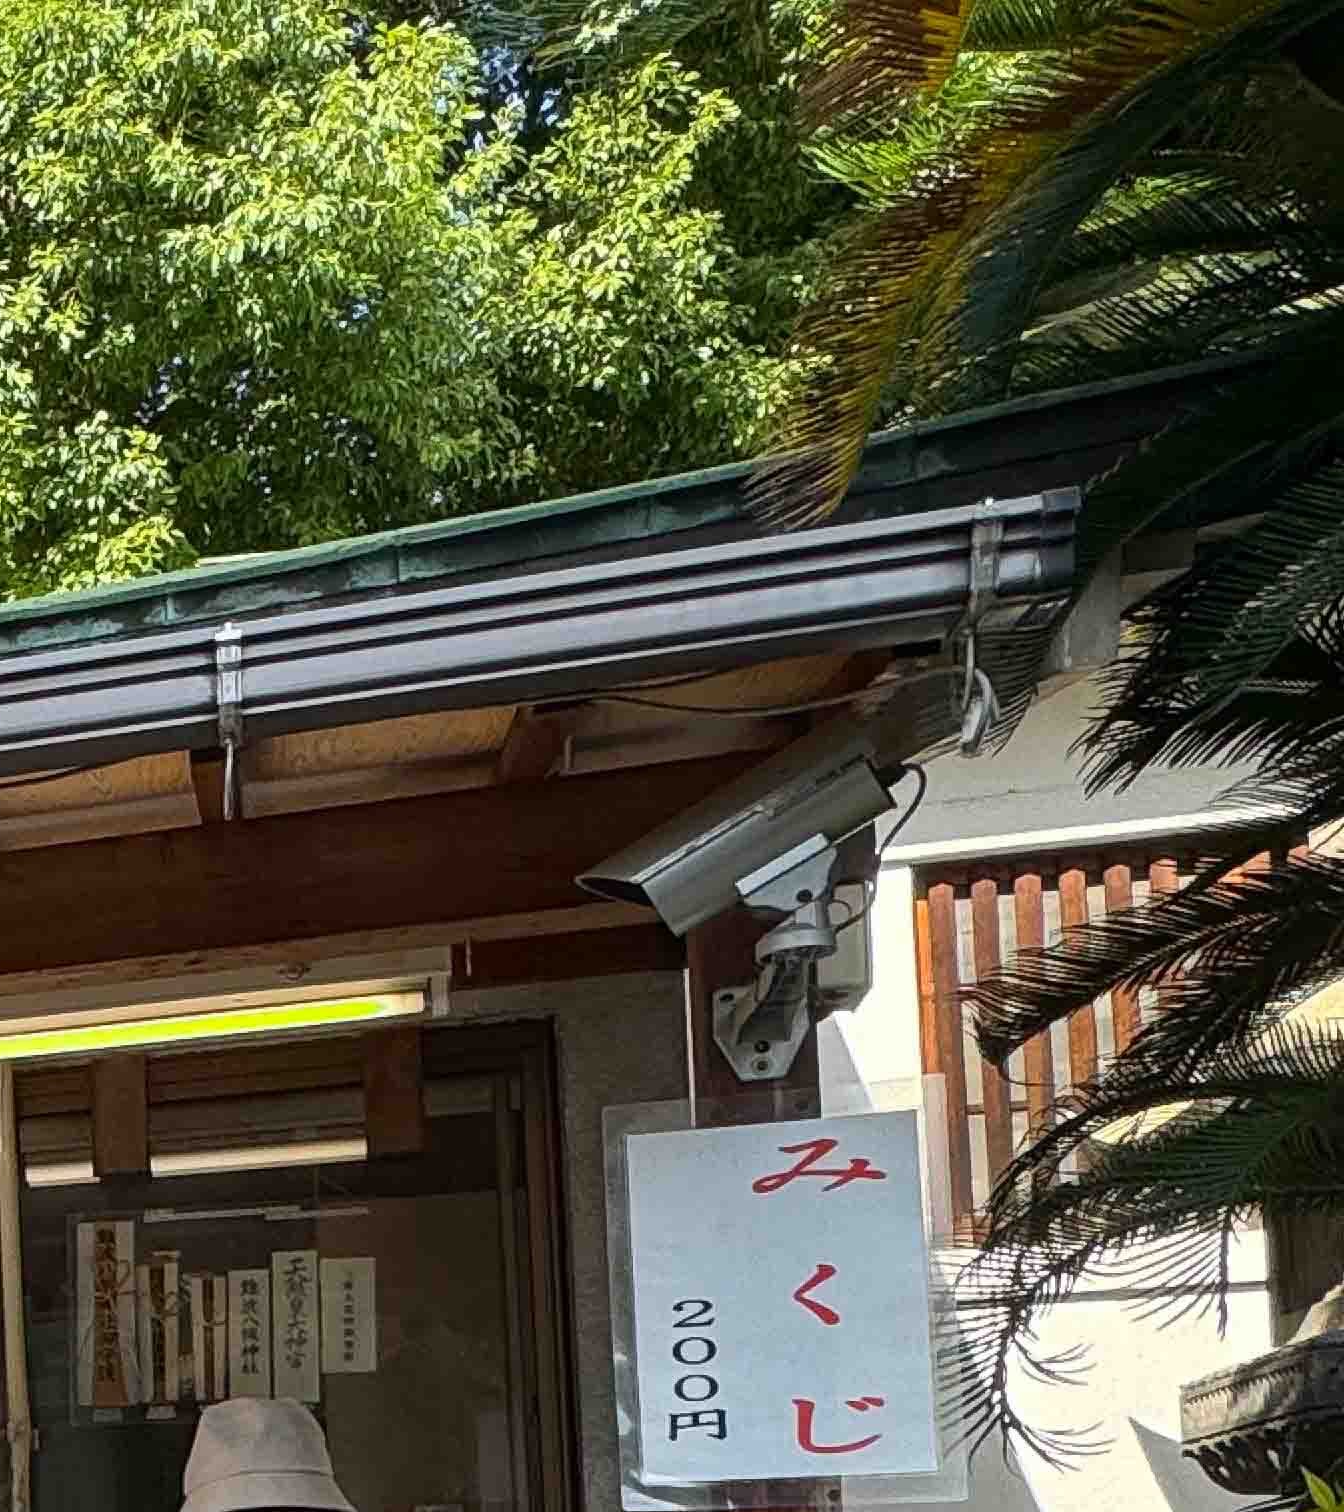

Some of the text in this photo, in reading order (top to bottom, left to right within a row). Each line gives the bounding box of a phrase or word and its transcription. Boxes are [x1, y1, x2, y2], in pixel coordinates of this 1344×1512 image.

[668, 1298, 728, 1441] 200円
[752, 1137, 887, 1454] みくじ
